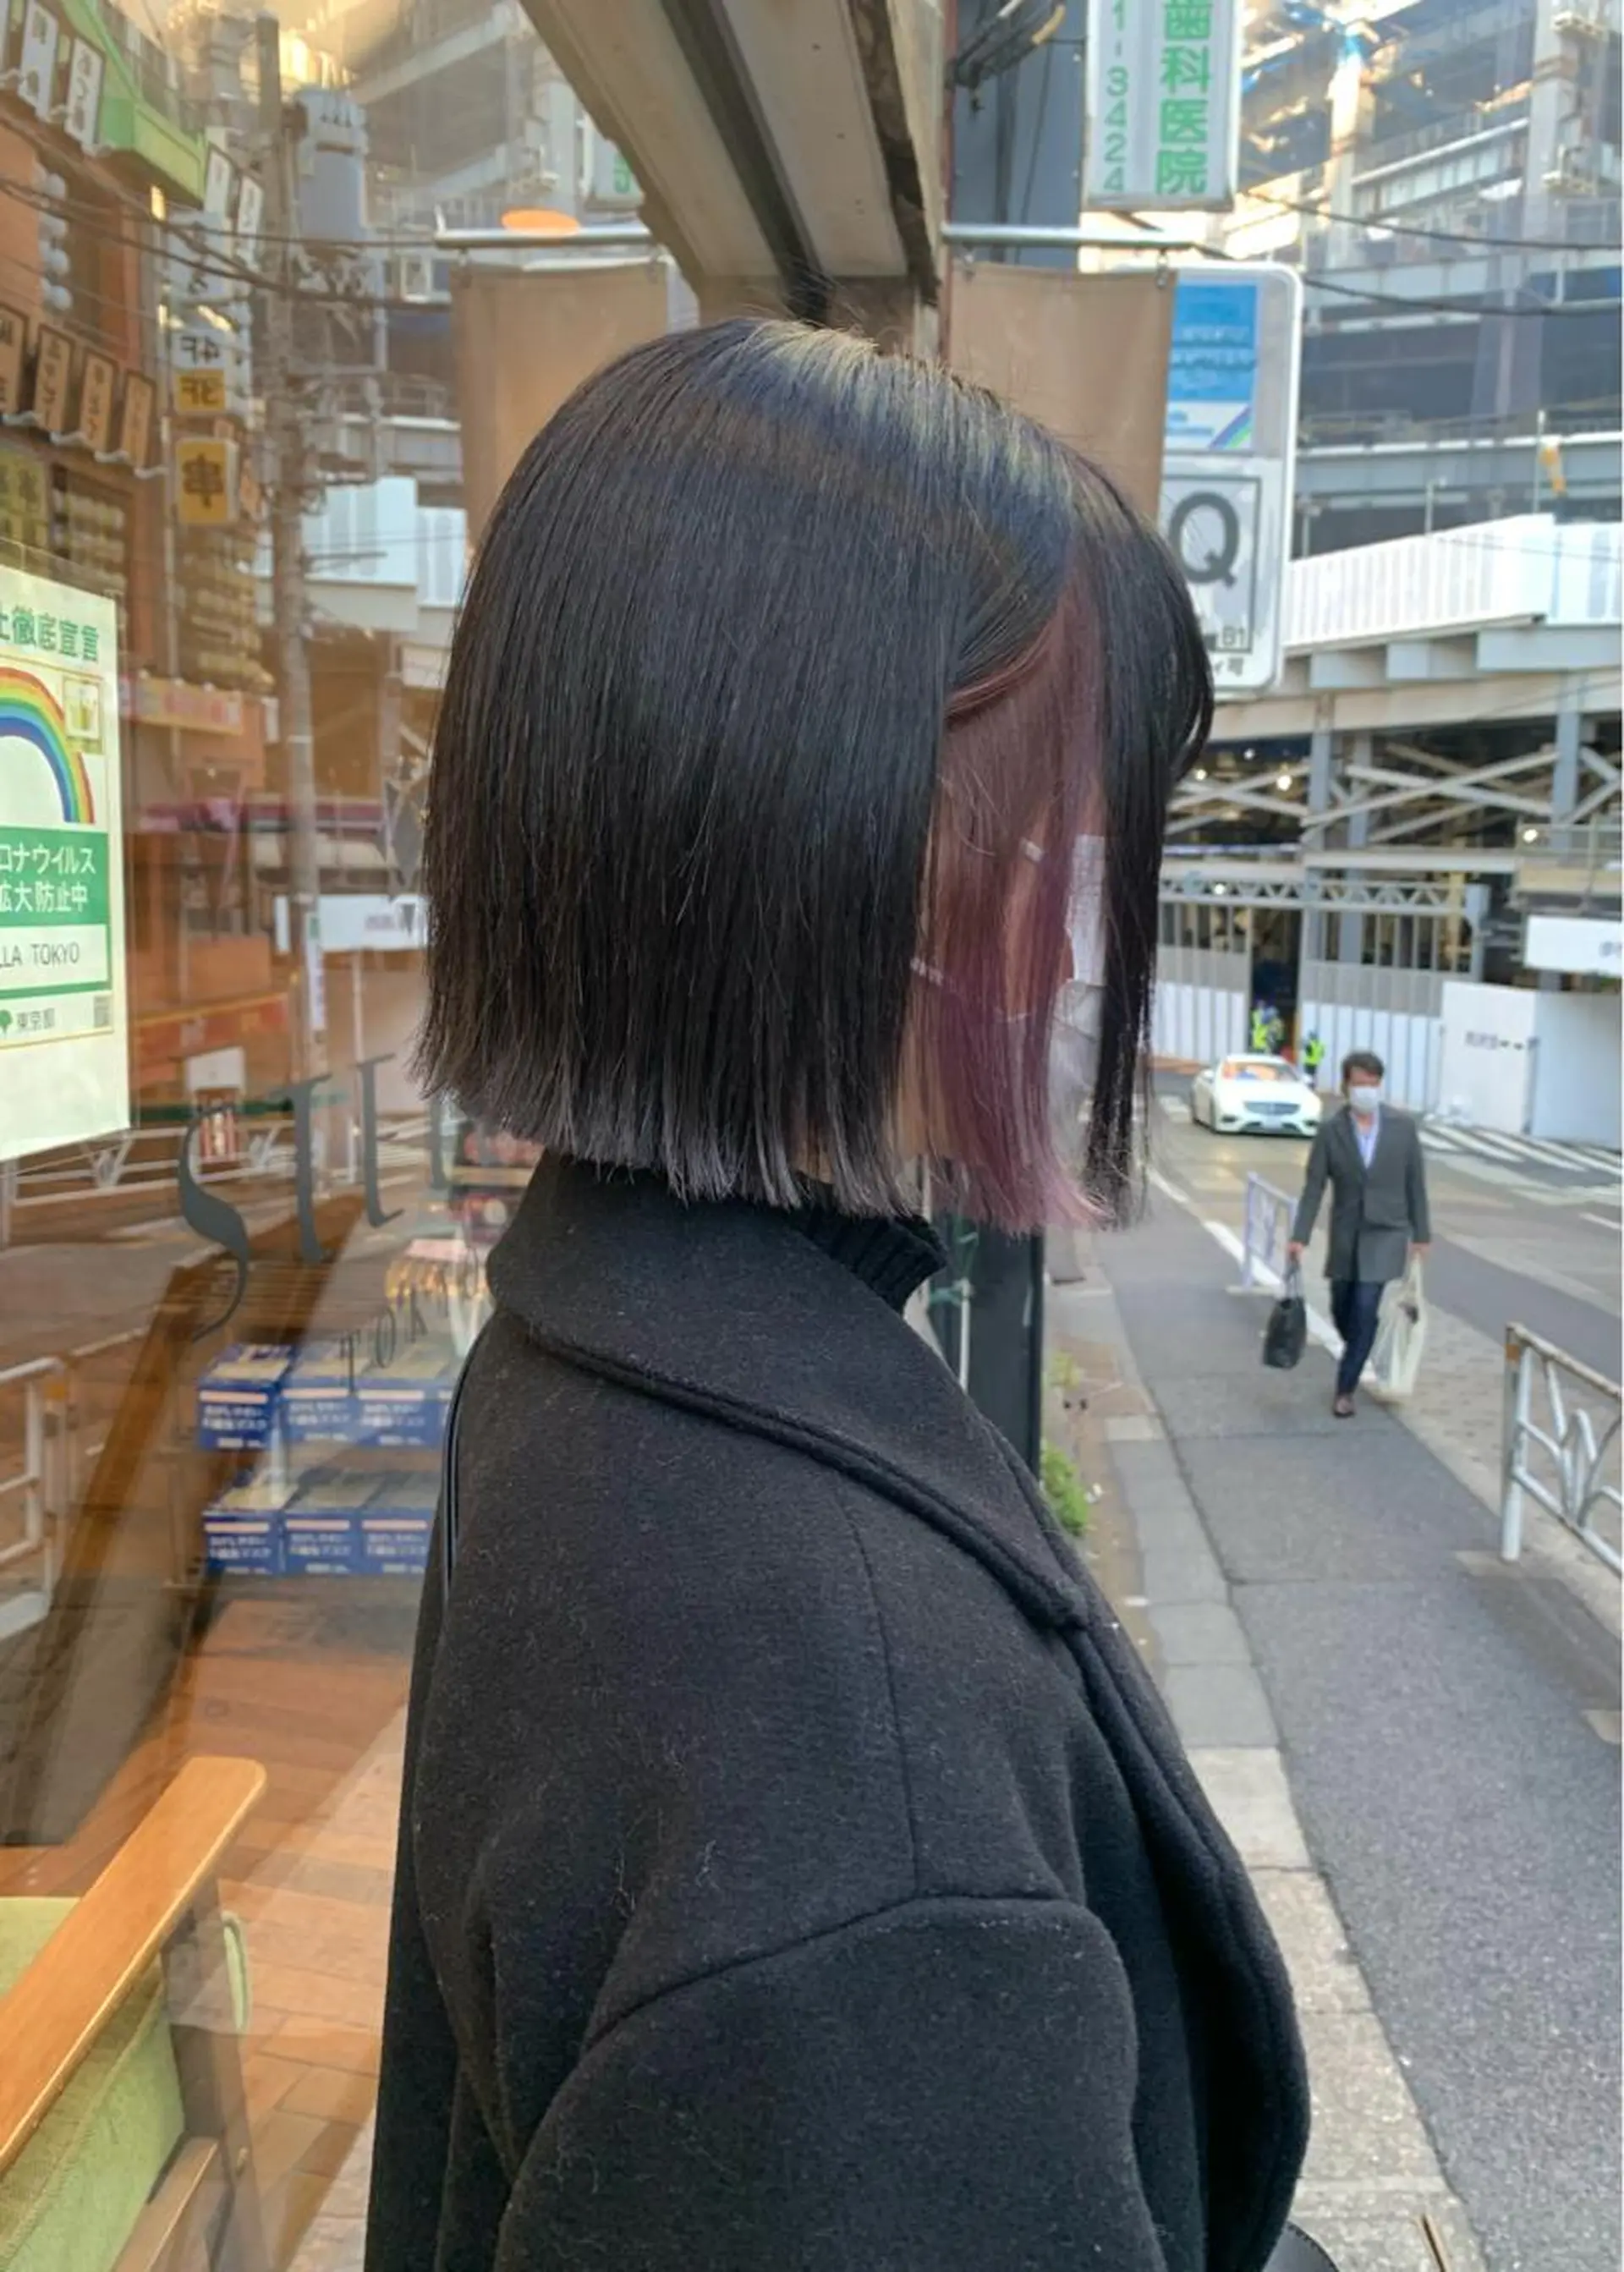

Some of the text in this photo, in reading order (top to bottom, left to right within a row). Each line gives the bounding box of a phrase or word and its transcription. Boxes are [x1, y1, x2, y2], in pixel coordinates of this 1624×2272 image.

[1157, 0, 1213, 193] 歯科医院
[1169, 492, 1239, 589] Q
[32, 942, 80, 967] TOKYO
